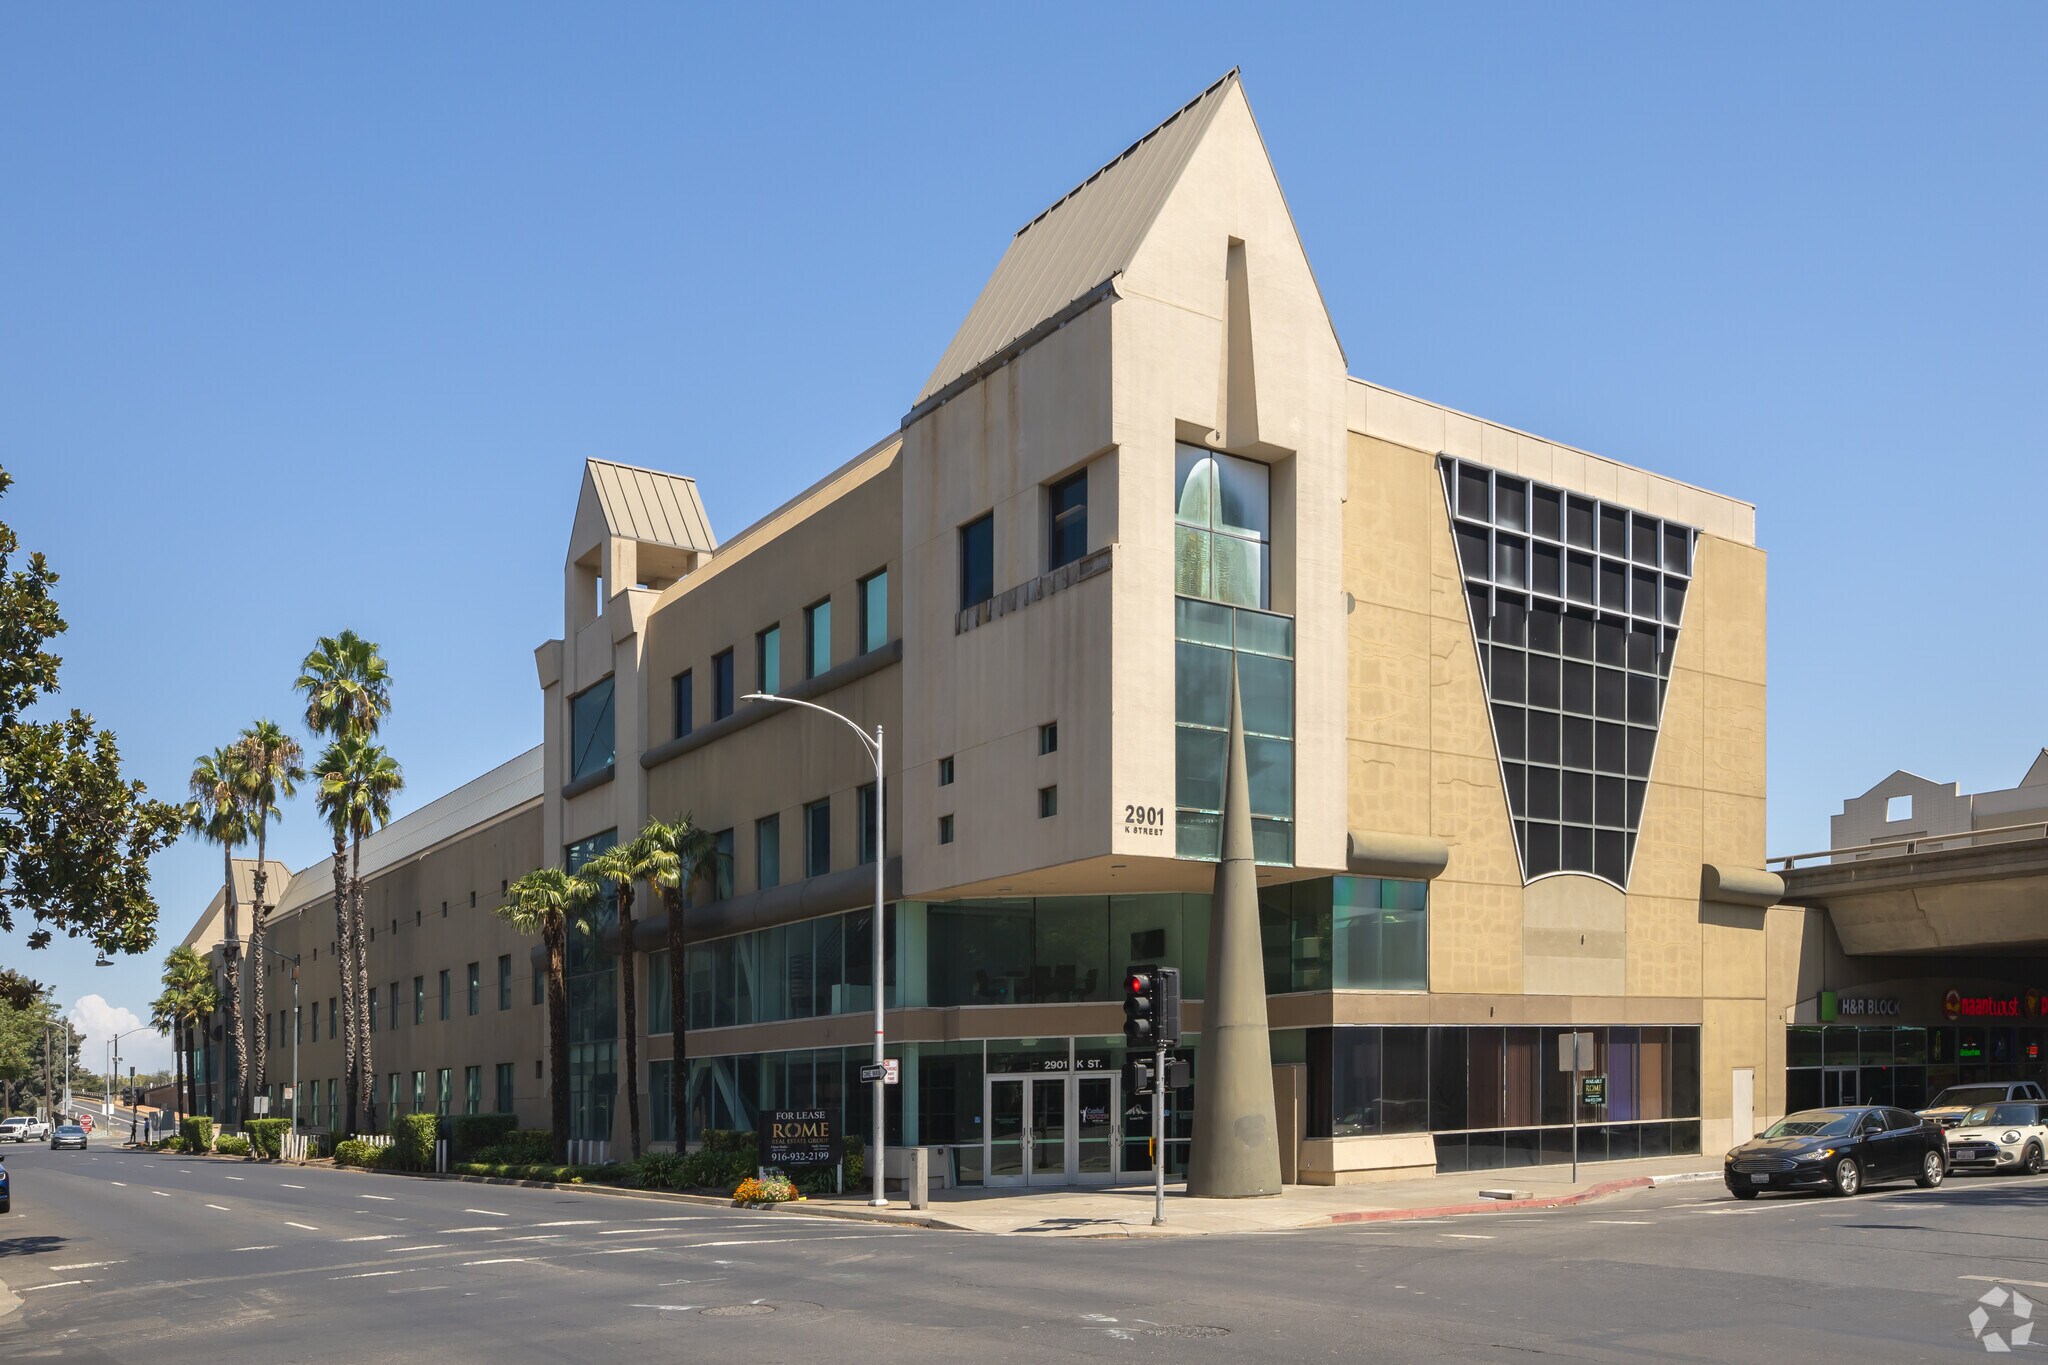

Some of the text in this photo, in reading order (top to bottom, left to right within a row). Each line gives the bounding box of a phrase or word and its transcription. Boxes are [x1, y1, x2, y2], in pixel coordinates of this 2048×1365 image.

[1125, 804, 1164, 826] 2901
[1124, 826, 1164, 836] K STREET
[1842, 999, 1901, 1015] H&R BLOCK
[1044, 1059, 1103, 1070] 2901 K ST.
[864, 1070, 872, 1078] ONE
[776, 1111, 826, 1120] FOR LEASE
[772, 1122, 830, 1138] ROME
[771, 1151, 830, 1162] 916-932-2199
